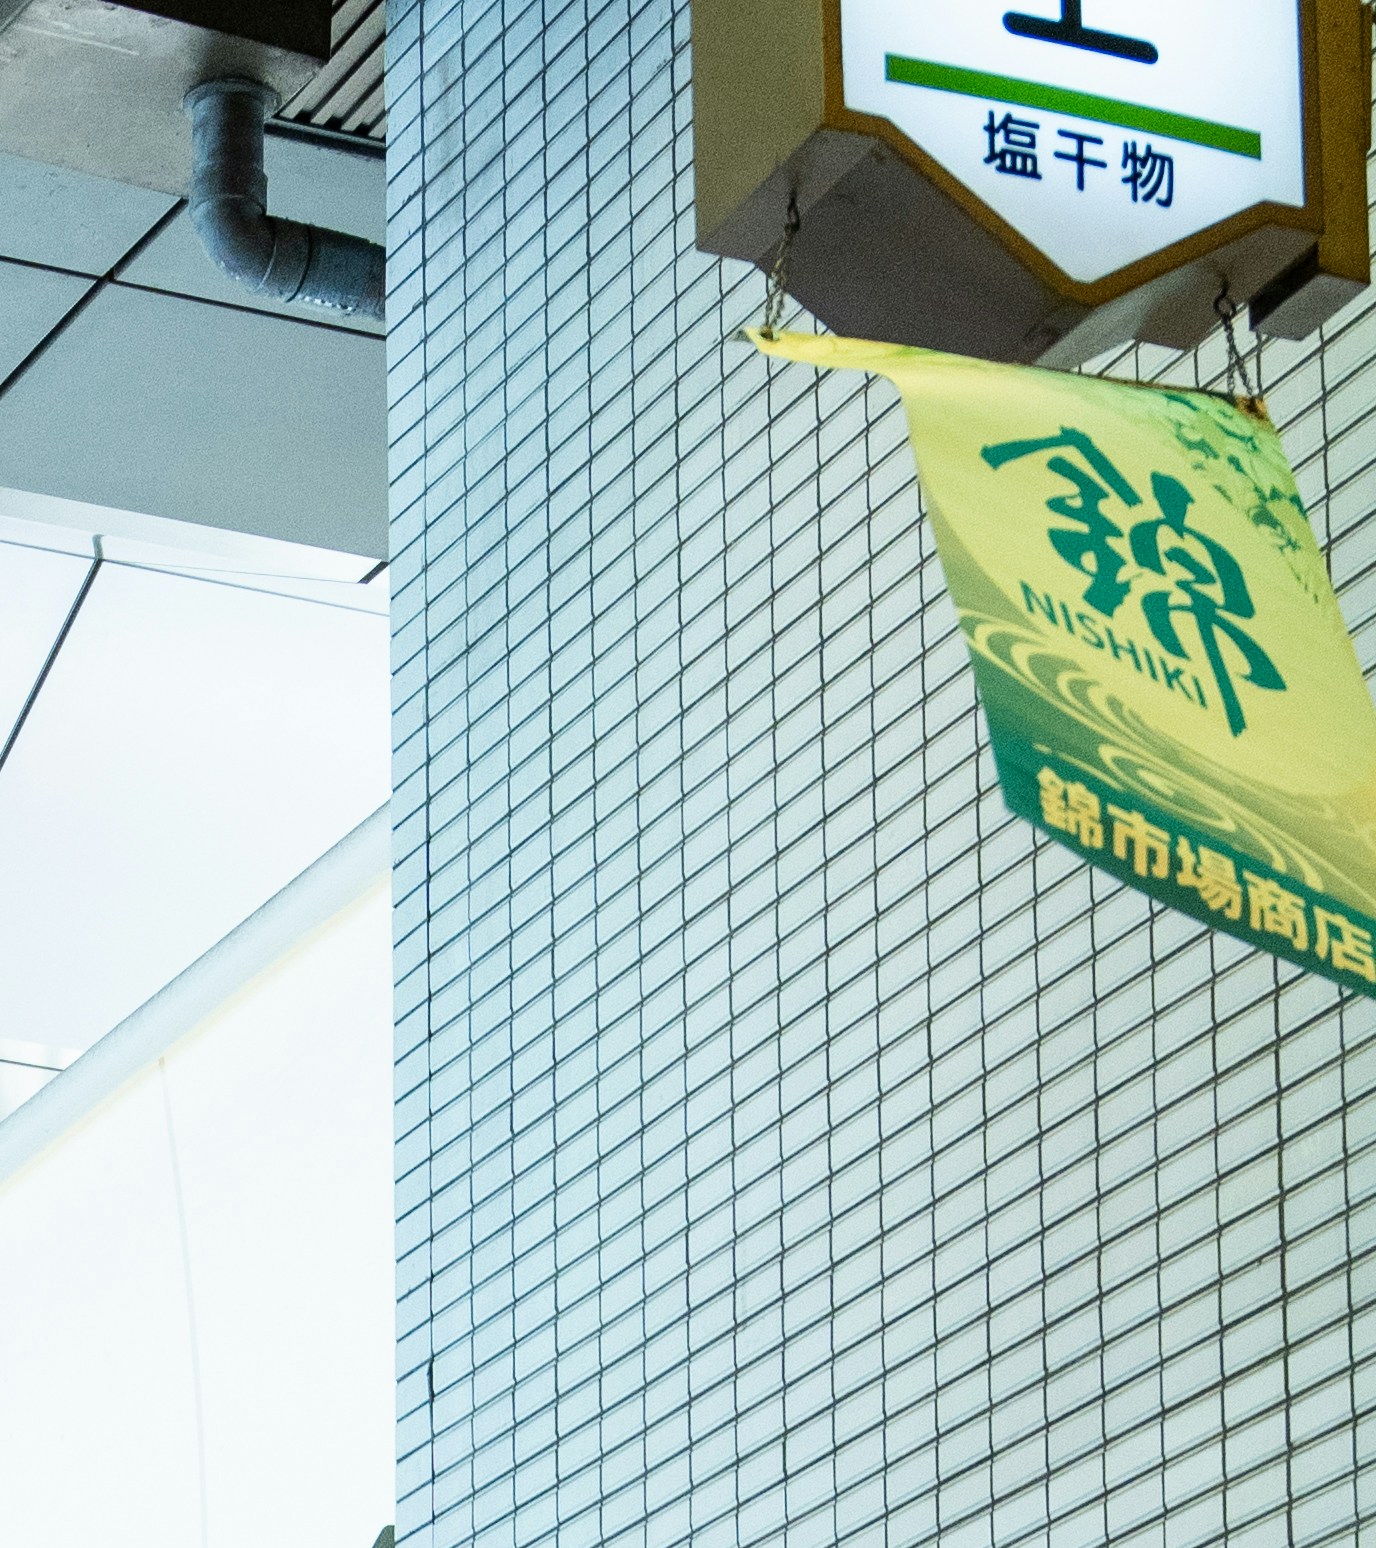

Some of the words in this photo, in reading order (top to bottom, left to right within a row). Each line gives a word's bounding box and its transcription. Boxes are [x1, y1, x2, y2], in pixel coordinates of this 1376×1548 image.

[982, 109, 1177, 209] 塩干物
[980, 426, 1286, 737] 錦
[1021, 580, 1208, 707] NISHIKI
